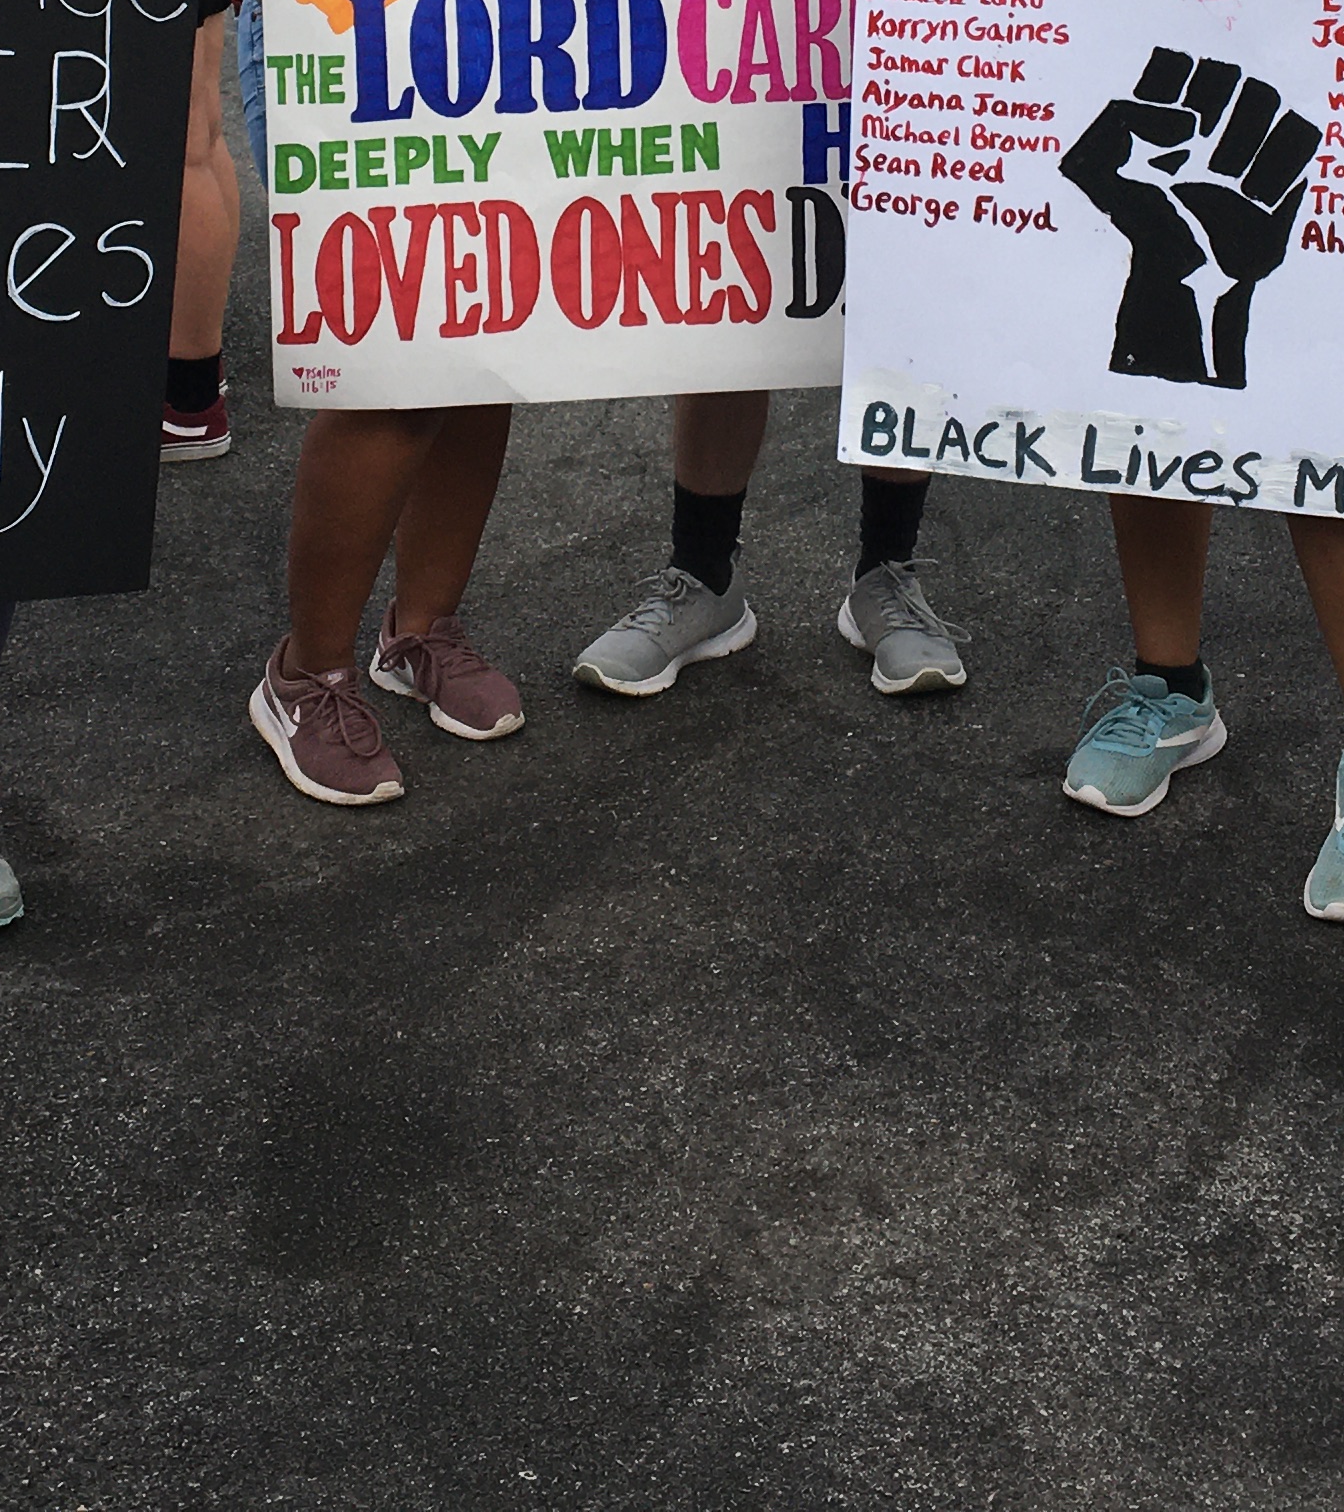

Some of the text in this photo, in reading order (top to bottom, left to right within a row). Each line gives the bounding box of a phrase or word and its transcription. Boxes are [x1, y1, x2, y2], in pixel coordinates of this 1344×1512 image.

[867, 9, 1070, 45] Korryn Gaines
[267, 54, 346, 105] THE
[867, 46, 949, 76] Jamar
[862, 78, 965, 114] Aiyana
[861, 113, 961, 147] Michael
[274, 131, 502, 195] DEEPLY
[543, 121, 720, 179] WHEN
[854, 142, 1005, 183] Sean Reed
[850, 181, 1059, 234] George Floyd
[272, 196, 541, 345] LOVED
[550, 189, 775, 328] ONES
[860, 400, 1057, 479] BLACK
[1080, 423, 1262, 508] Lives
